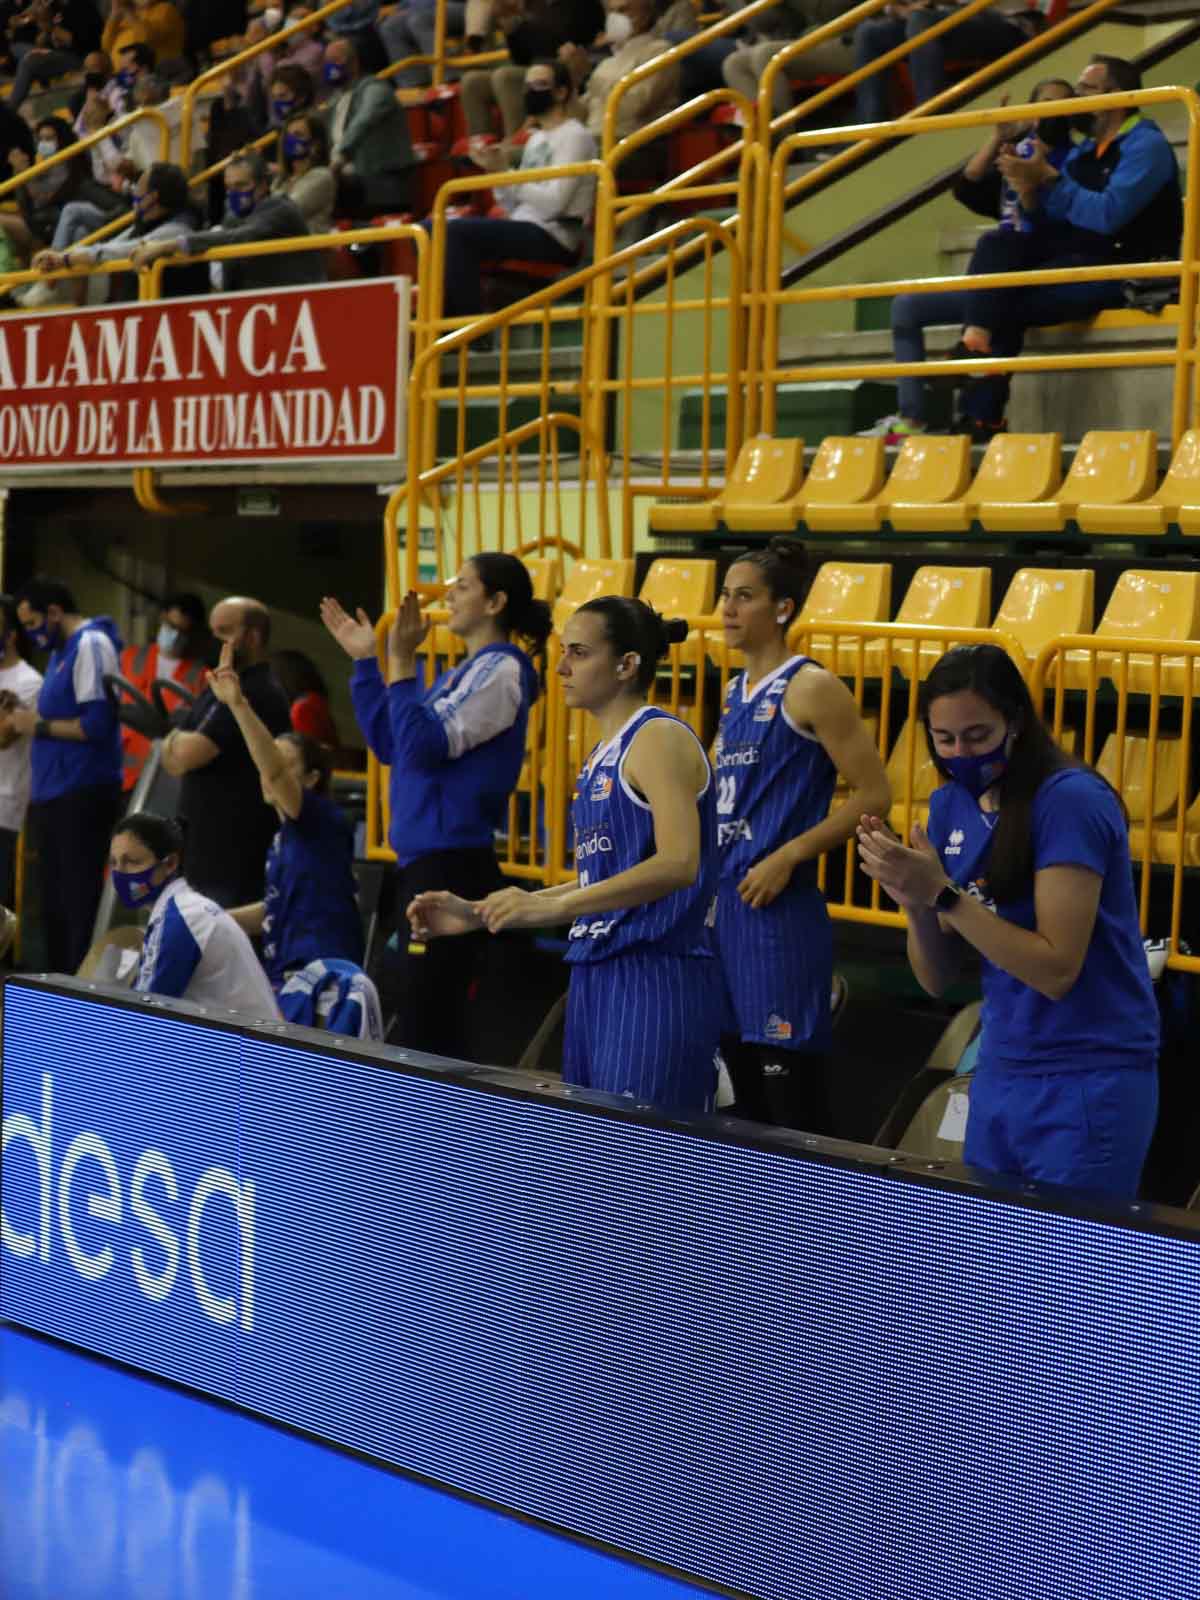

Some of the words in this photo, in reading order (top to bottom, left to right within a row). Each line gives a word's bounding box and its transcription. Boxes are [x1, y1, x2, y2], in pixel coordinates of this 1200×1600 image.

[75, 400, 119, 456] DE
[125, 397, 165, 455] LA
[172, 384, 387, 454] HUMANIDAD
